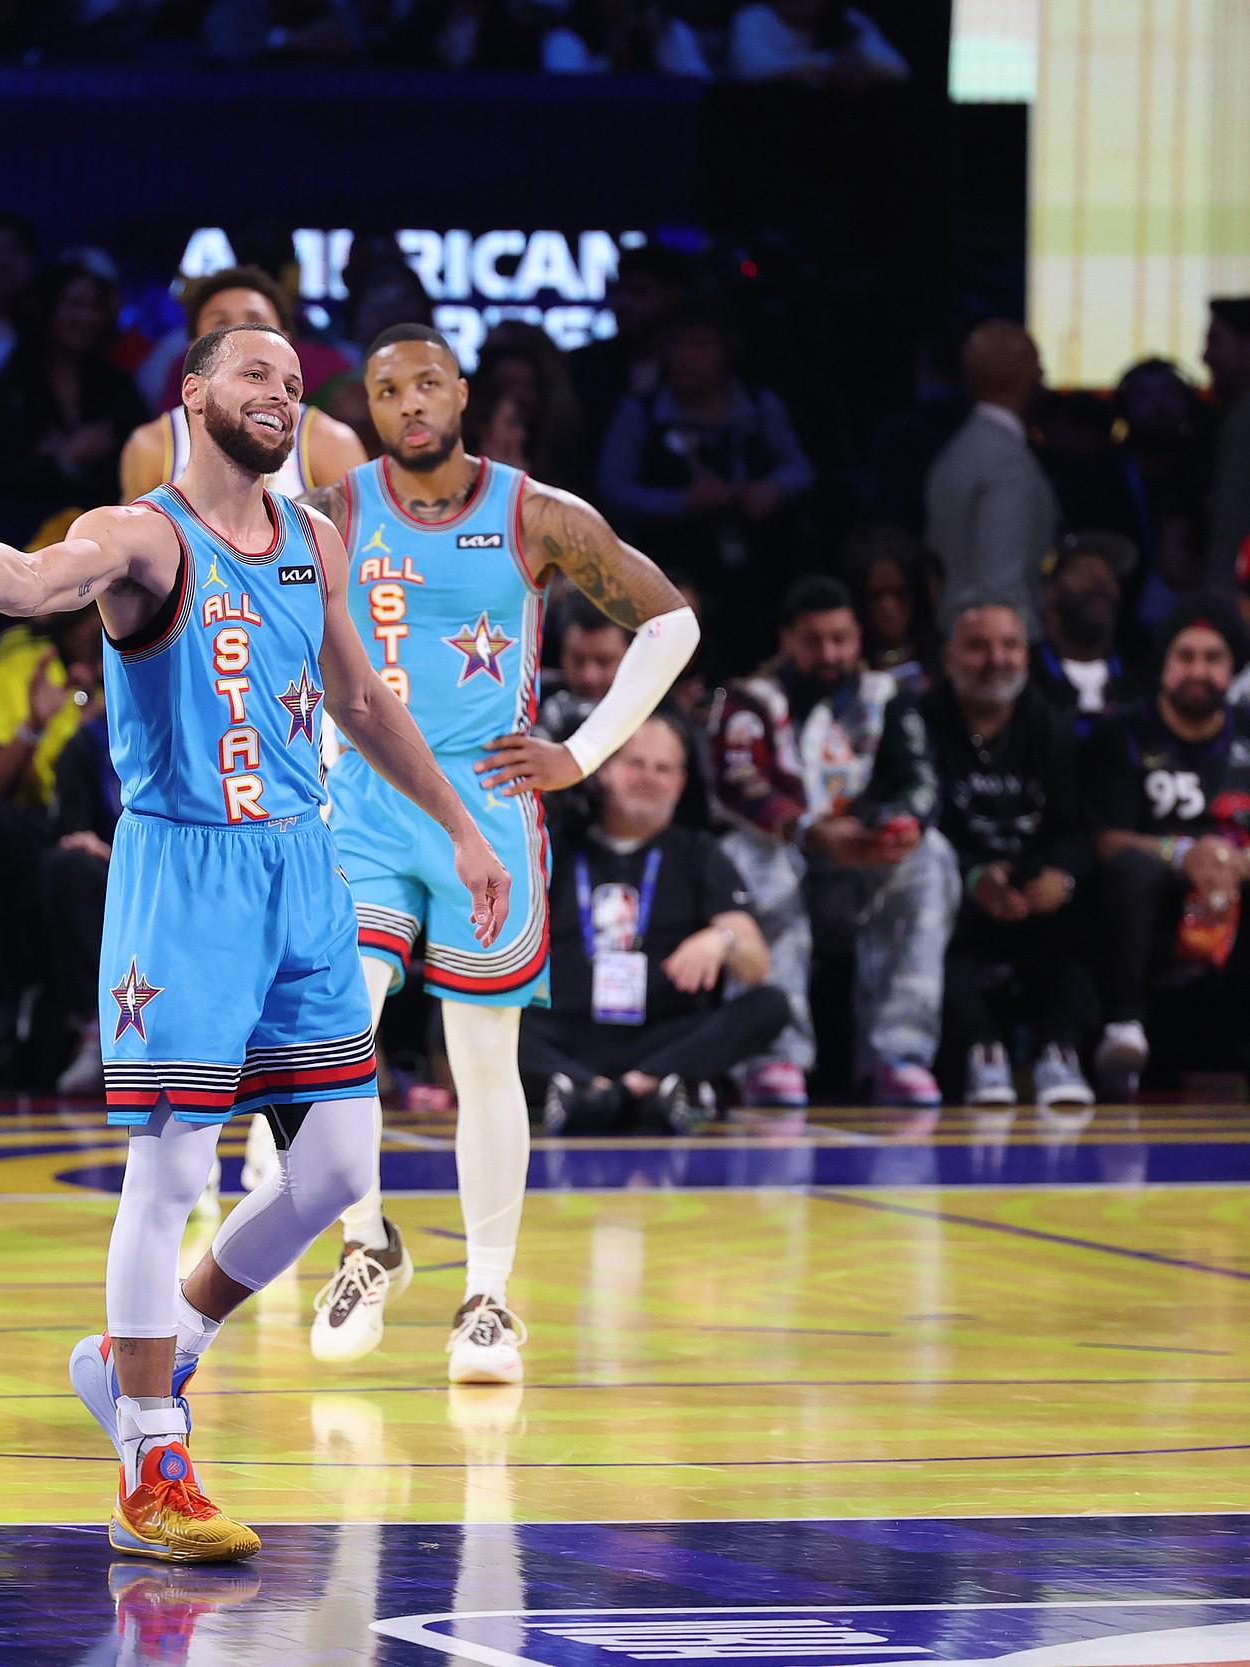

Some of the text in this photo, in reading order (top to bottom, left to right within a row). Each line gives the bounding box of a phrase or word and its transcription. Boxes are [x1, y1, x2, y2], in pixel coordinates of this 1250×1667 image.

[358, 556, 425, 585] ALL
[202, 592, 262, 627] ALL
[368, 583, 410, 705] STA
[1145, 770, 1206, 820] 95
